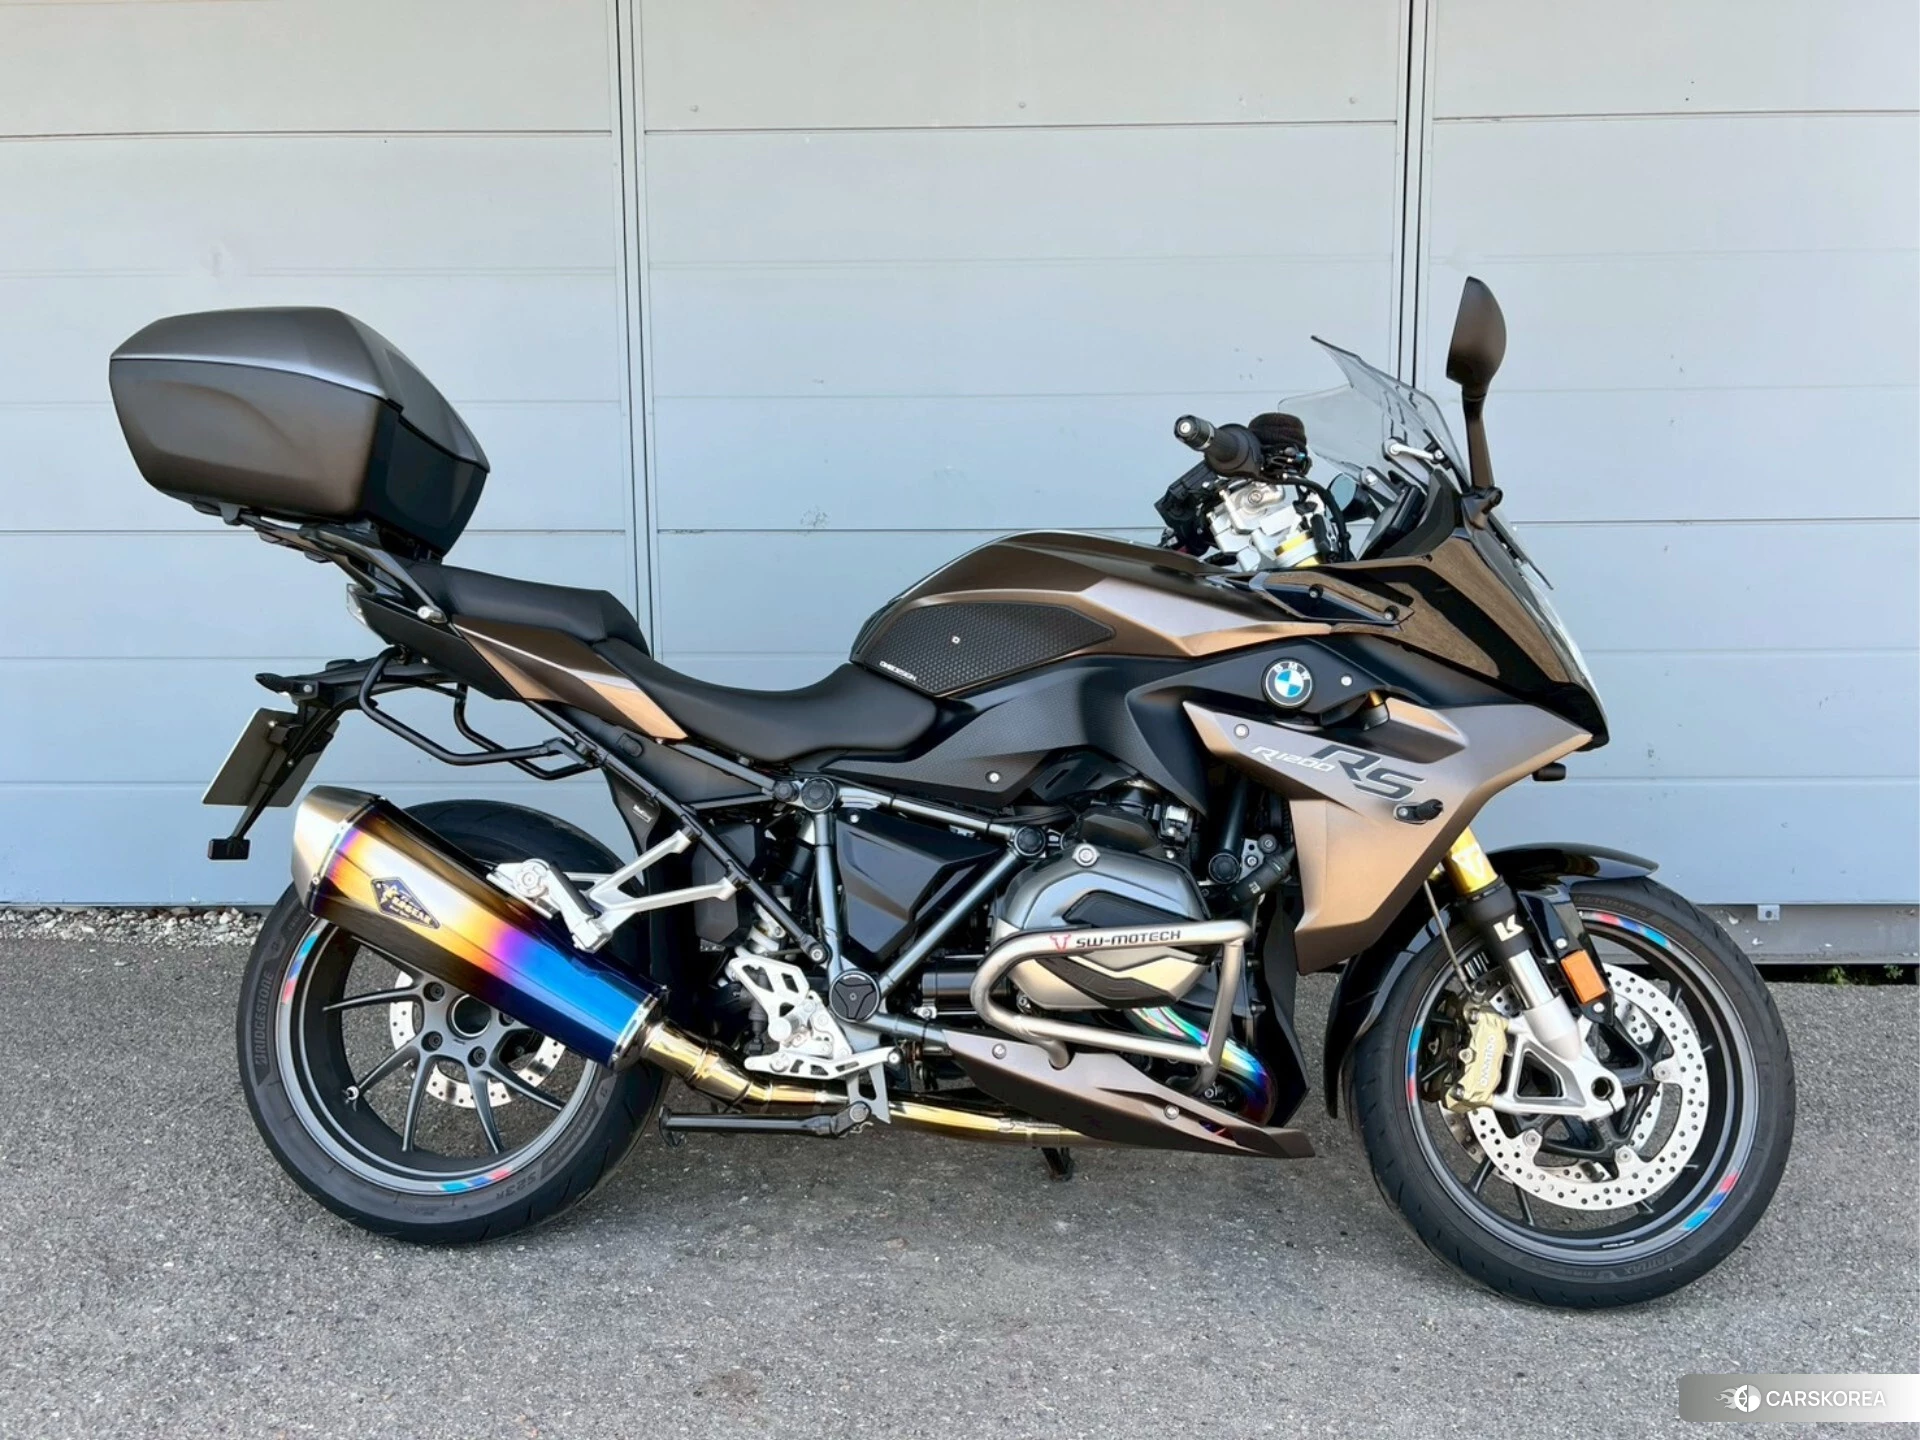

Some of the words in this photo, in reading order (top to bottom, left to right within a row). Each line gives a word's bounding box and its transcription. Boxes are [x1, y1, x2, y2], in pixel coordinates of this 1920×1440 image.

[1273, 661, 1311, 681] BMW
[1251, 746, 1336, 773] R1200
[1310, 744, 1427, 802] RS
[1075, 930, 1181, 949] SW-MOTECH
[254, 969, 275, 1067] BRIDGESTONE
